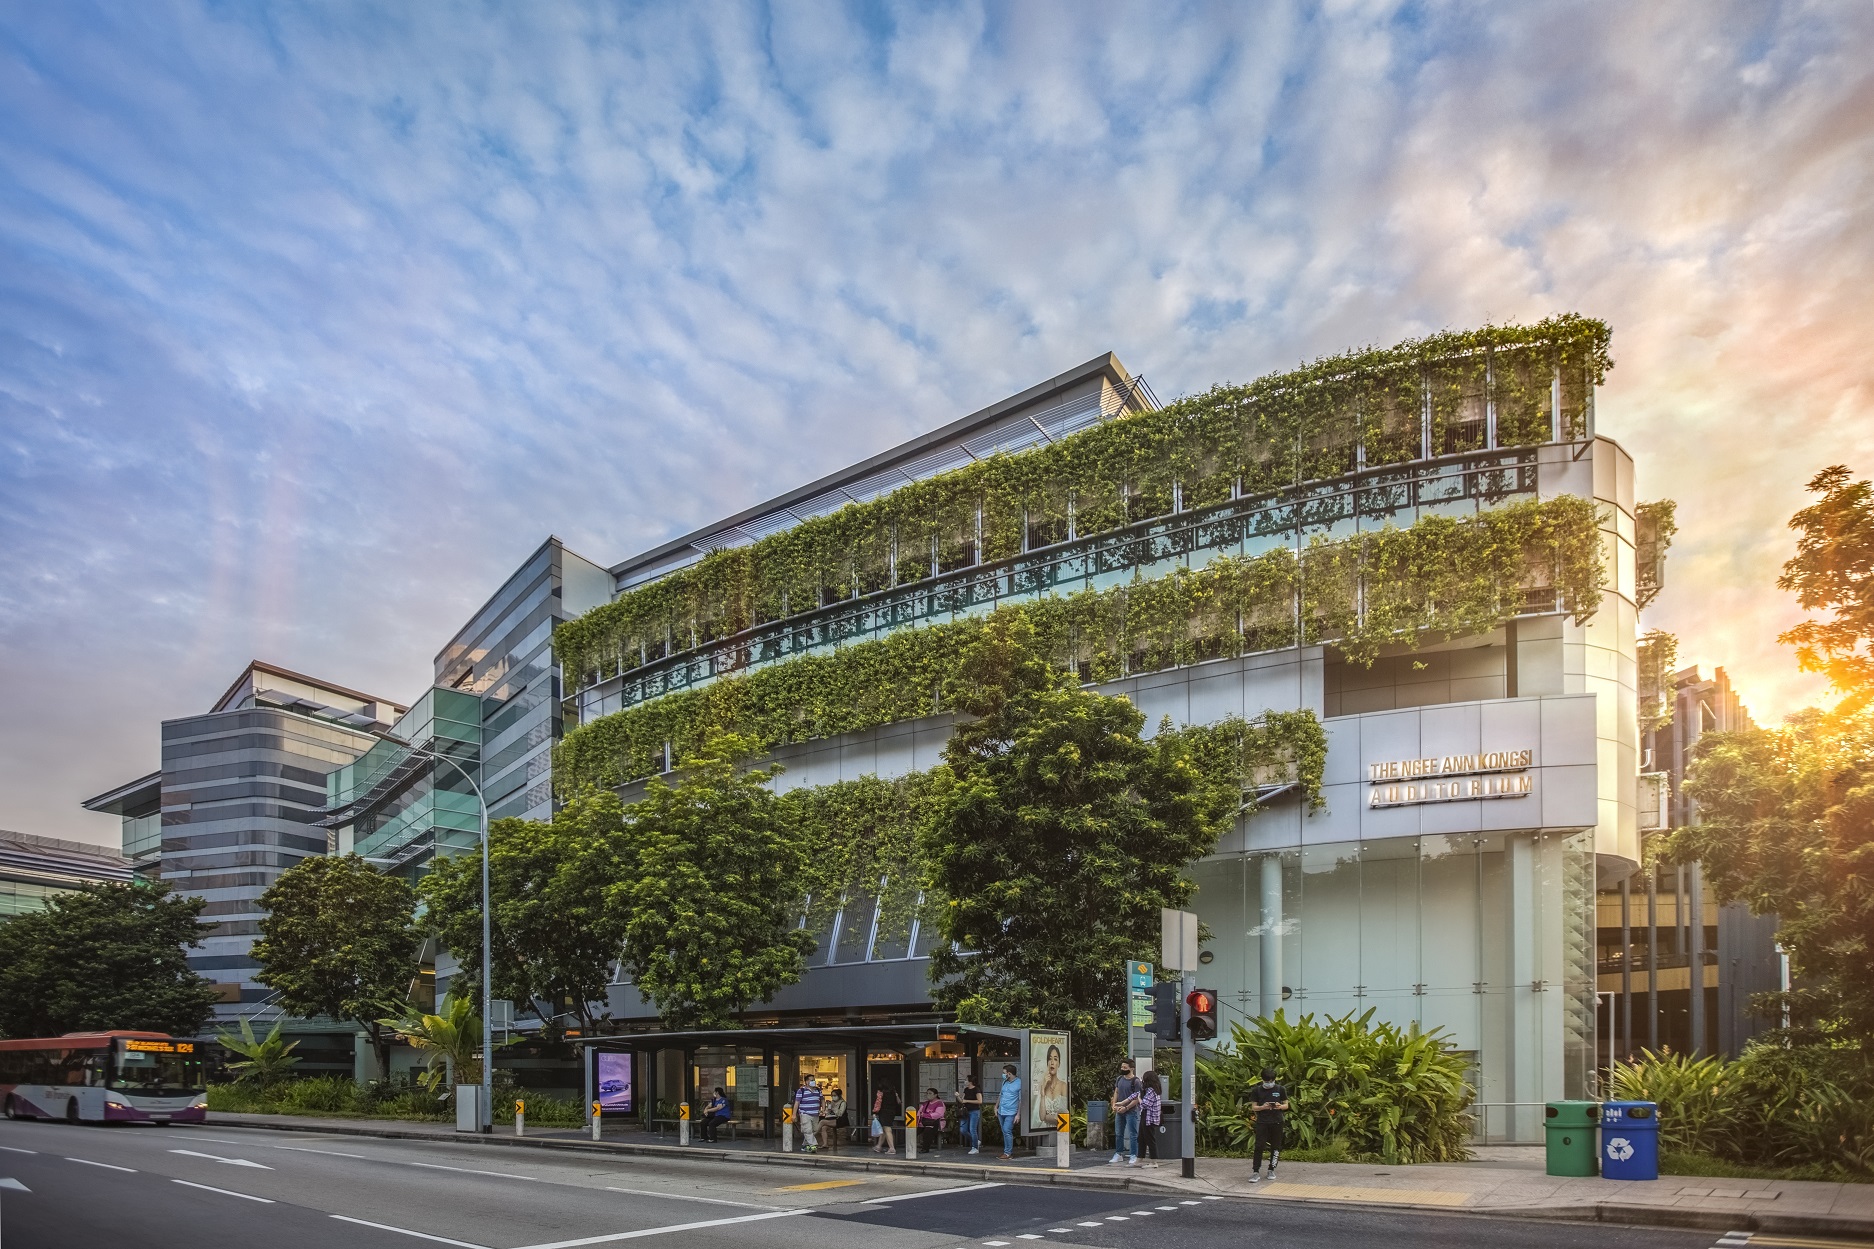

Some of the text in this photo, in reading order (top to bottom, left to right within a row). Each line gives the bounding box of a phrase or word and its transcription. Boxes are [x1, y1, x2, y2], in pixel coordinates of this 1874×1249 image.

[1371, 750, 1533, 779] THE NGEE ANN KONGSI
[1371, 776, 1533, 804] AUDITORIUM
[177, 1043, 194, 1053] 124
[1032, 1036, 1065, 1045] GOLDHEART
